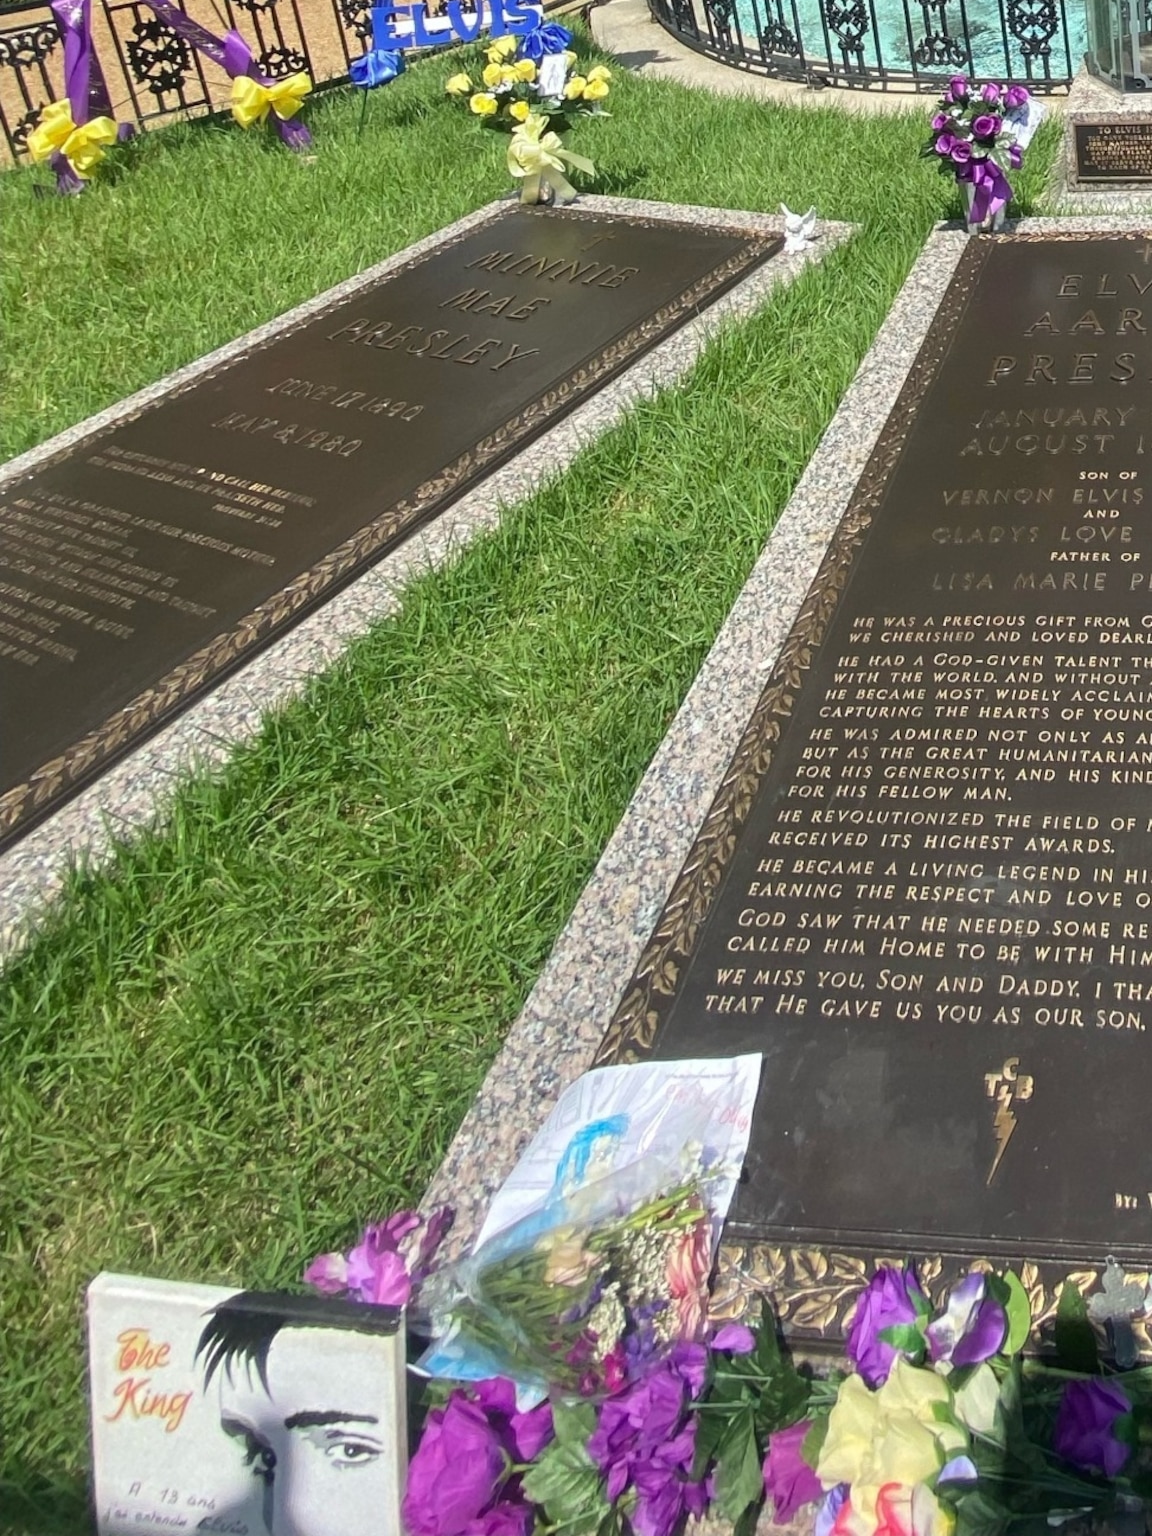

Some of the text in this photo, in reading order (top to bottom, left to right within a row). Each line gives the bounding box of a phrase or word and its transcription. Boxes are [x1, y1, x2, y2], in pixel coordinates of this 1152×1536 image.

[1115, 126, 1141, 134] ELVIS
[464, 249, 640, 288] MINNIE
[438, 287, 551, 319] MAE
[325, 318, 540, 372] PRESLEY
[265, 377, 338, 401] JUNE
[211, 412, 279, 434] MAY
[970, 404, 1135, 429] JANUARY
[959, 434, 1115, 456] AUGUST
[1079, 471, 1137, 480] SON OF
[942, 488, 1055, 507] VERNON
[1072, 488, 1144, 505] ELVIS
[1083, 509, 1120, 519] AND
[931, 526, 1040, 545] GLADYS
[1061, 526, 1133, 543] LOVE
[1050, 551, 1141, 562] FATHER OF
[931, 572, 994, 592] LISA
[1013, 572, 1107, 591] MARIE
[849, 632, 871, 644] WE
[881, 631, 976, 644] CHERISHED
[984, 631, 1021, 643] AND
[1031, 632, 1088, 644] LOVED
[833, 672, 879, 684] WITH
[890, 671, 924, 684] THE
[1004, 672, 1044, 684] AND
[1055, 673, 1141, 686] WITHOUT
[825, 689, 847, 700] HE
[855, 689, 926, 700] BECAME
[935, 688, 985, 701] MOST
[995, 689, 1061, 702] WIDELY
[819, 706, 923, 718] CAPTURING
[934, 706, 969, 718] THE
[978, 707, 1050, 719] HEARTS
[1060, 708, 1085, 720] OF
[809, 729, 833, 741] HE
[843, 728, 879, 741] WAS
[888, 728, 978, 741] ADMIRED
[987, 729, 1028, 742] NOT
[1038, 730, 1091, 744] ONLY
[1102, 732, 1125, 744] AS
[802, 747, 838, 760] BUT
[847, 747, 870, 760] AS
[880, 747, 914, 760] THE
[926, 747, 987, 760] GREAT
[999, 748, 1152, 764] HUMANITARIAN
[796, 766, 832, 779] FOR
[841, 766, 873, 779] HIS
[1015, 768, 1056, 781] AND
[1068, 769, 1100, 783] HIS
[777, 810, 800, 823] HE
[811, 810, 984, 826] REVOLUTIONIZED
[995, 814, 1031, 828] THE
[1042, 816, 1099, 830] FIELD
[1111, 817, 1136, 831] OF
[768, 832, 868, 846] RECEIVED
[880, 833, 912, 849] ITS
[924, 834, 1013, 850] HIGHEST
[757, 859, 784, 873] HE
[792, 860, 874, 875] BECAME
[884, 861, 897, 875] A
[909, 863, 983, 878] LIVING
[998, 865, 1081, 882] LEGEND
[1094, 868, 1113, 882] IN
[748, 882, 843, 899] EARNING
[856, 884, 895, 900] THE
[905, 885, 995, 903] RESPECT
[1007, 889, 1051, 905] AND
[1066, 890, 1122, 907] LOVE
[116, 1327, 172, 1372] The
[103, 1376, 194, 1434] King
